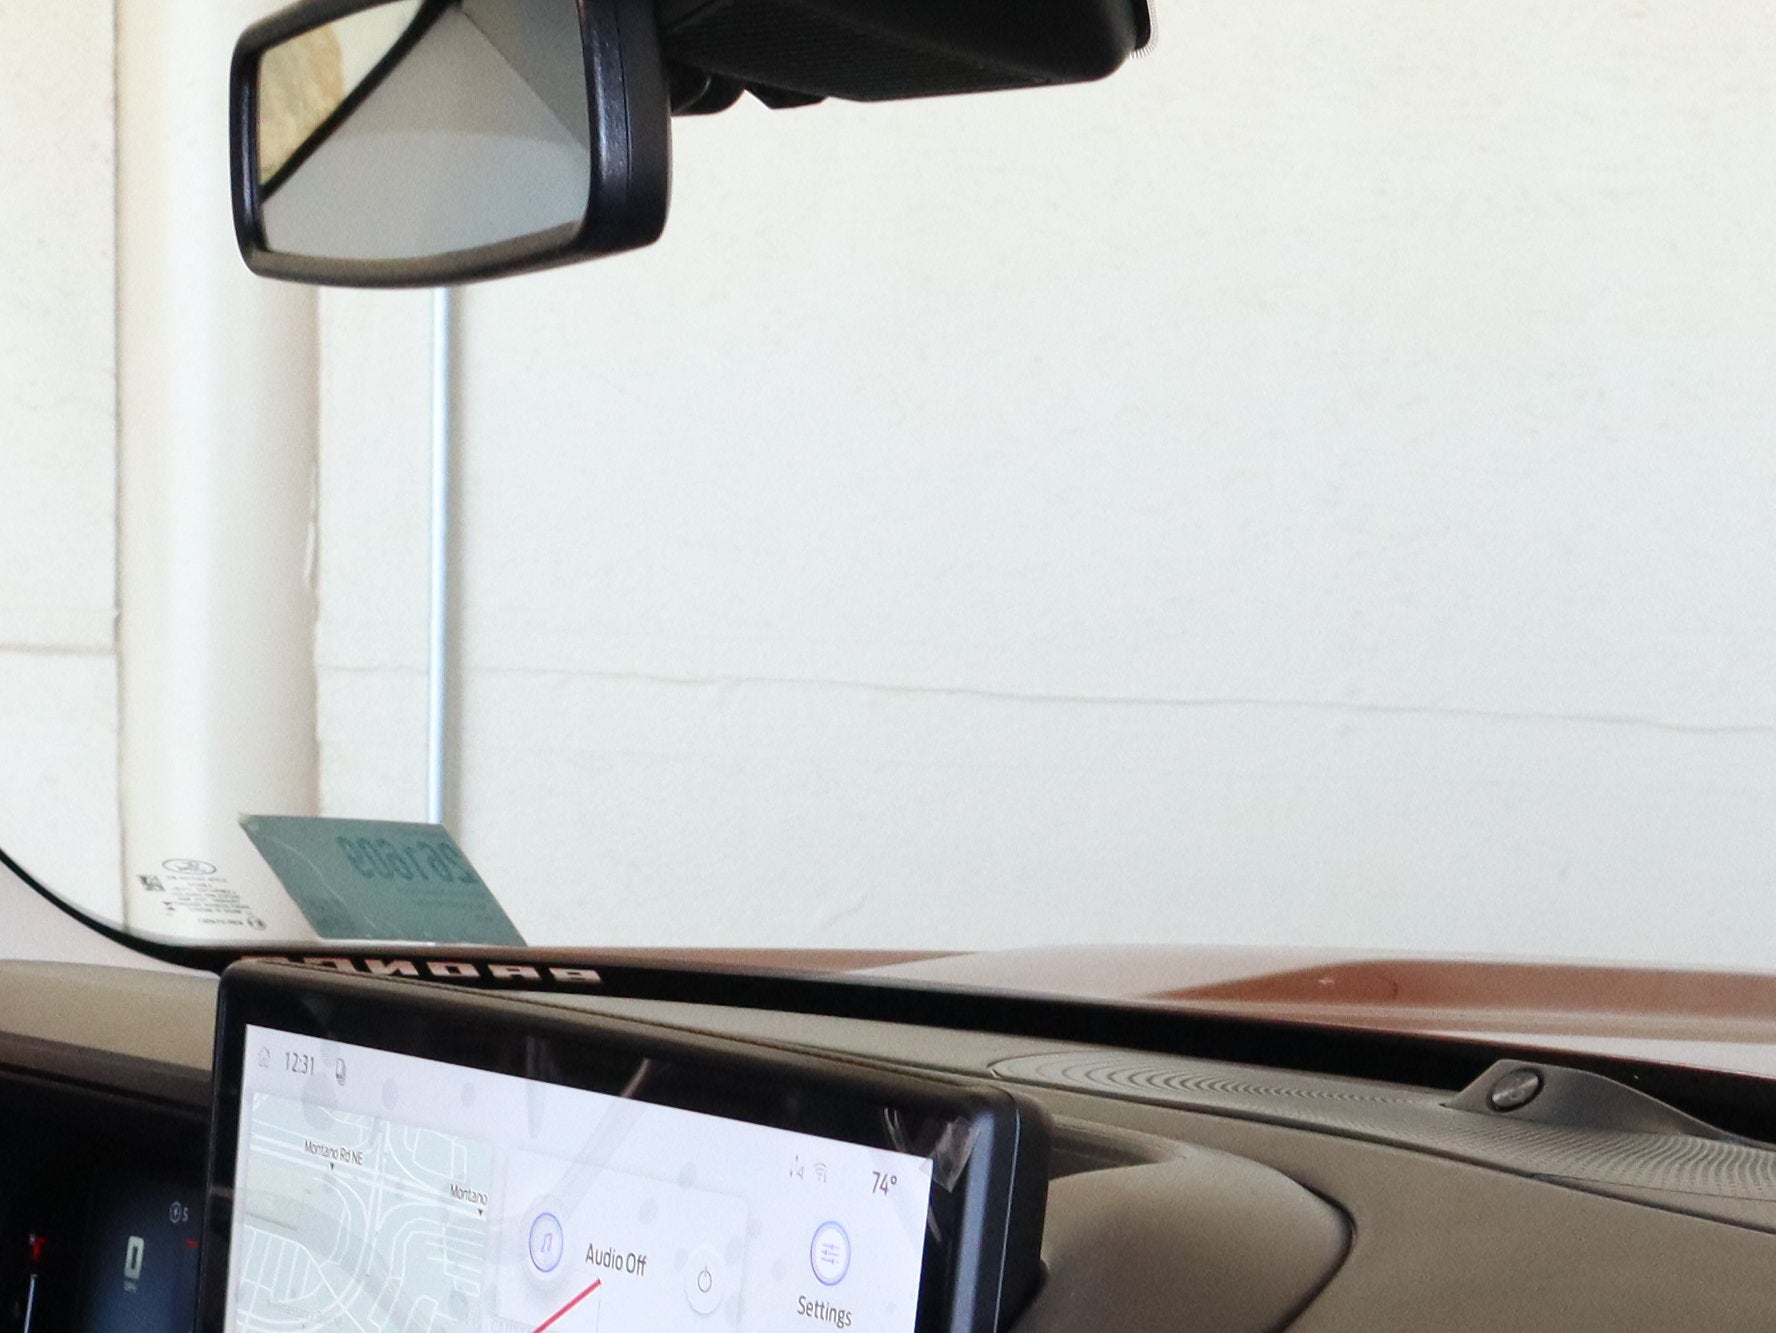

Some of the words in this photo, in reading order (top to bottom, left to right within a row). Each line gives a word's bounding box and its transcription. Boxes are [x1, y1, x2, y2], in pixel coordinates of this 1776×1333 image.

[284, 1051, 316, 1077] 12:31
[304, 1139, 339, 1160] Montano
[340, 1147, 352, 1162] Rd
[352, 1150, 365, 1165] NE
[450, 1183, 489, 1204] Montano
[872, 1170, 898, 1196] 74°
[585, 1242, 624, 1271] Audio
[626, 1253, 648, 1276] Off
[796, 1295, 853, 1329] Settings
